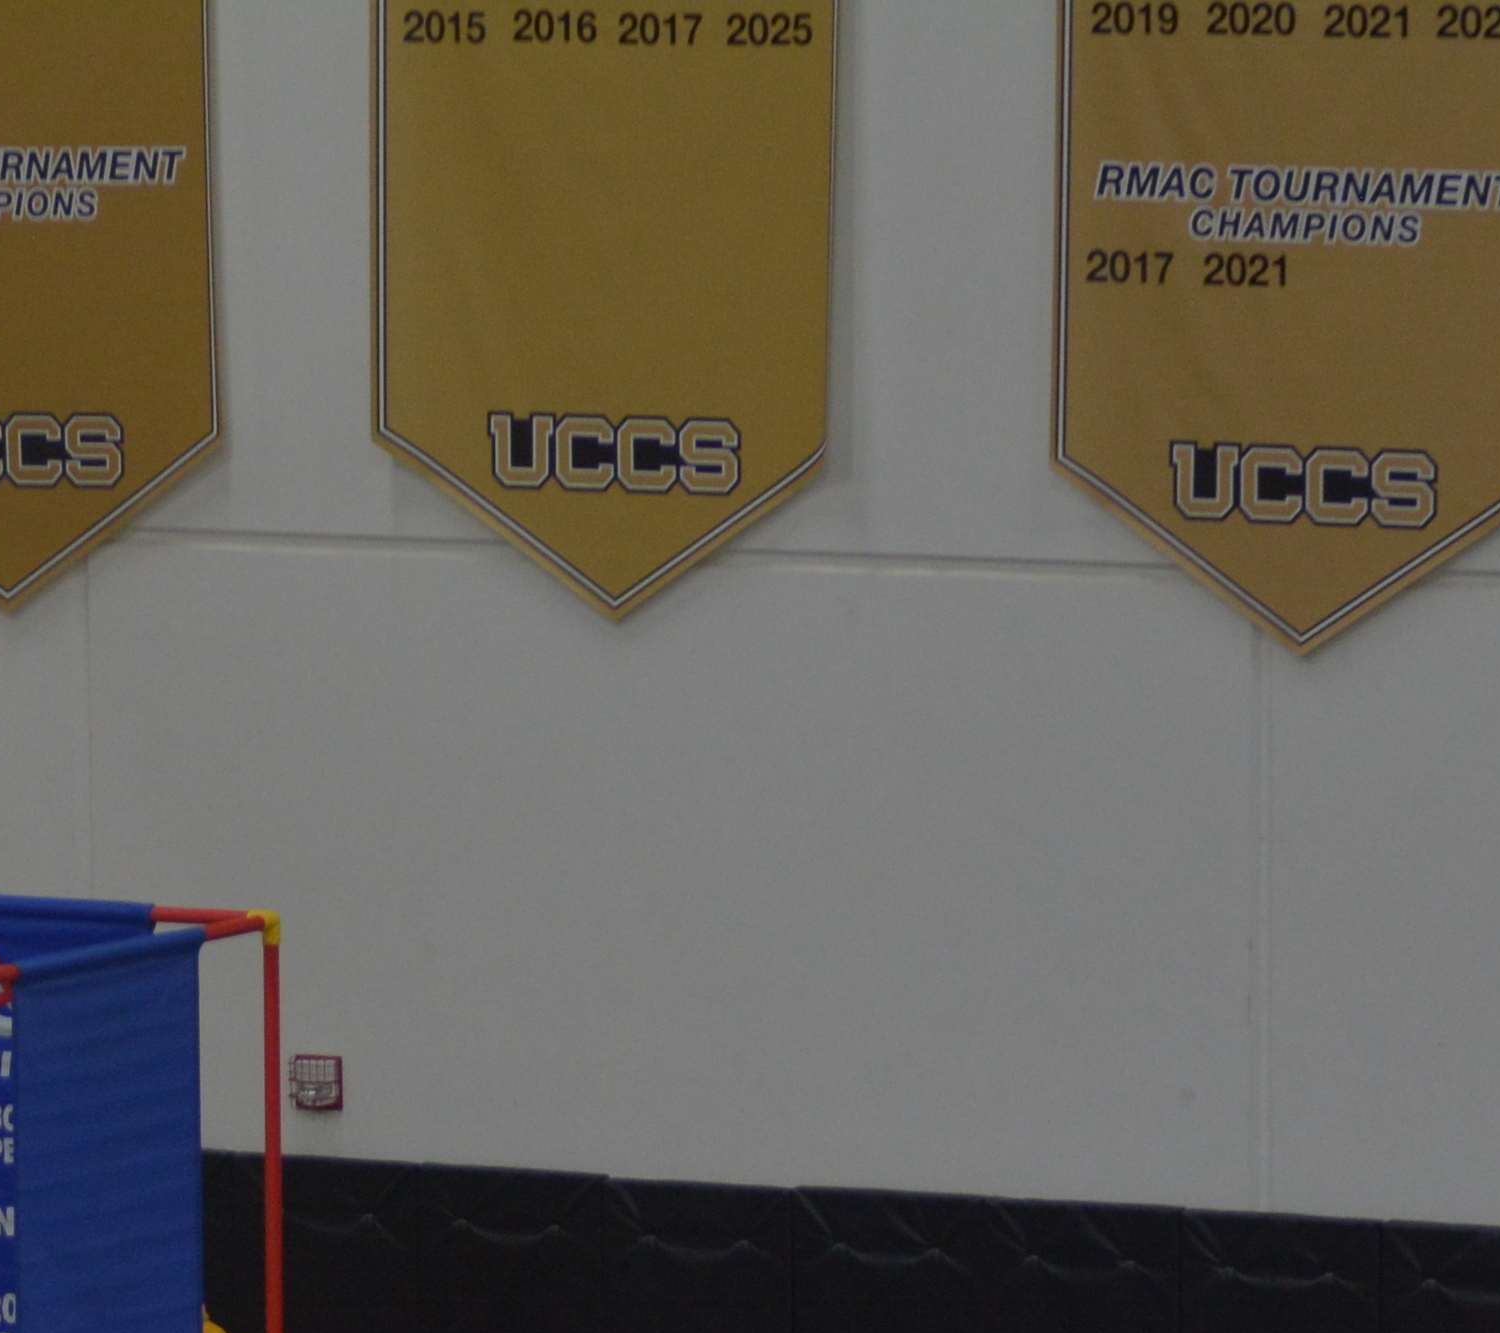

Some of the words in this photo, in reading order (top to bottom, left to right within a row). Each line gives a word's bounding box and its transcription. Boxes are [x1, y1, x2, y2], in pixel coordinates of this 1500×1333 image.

[402, 11, 487, 43] 2015
[513, 11, 598, 43] 2016
[618, 12, 702, 45] 2017
[726, 13, 813, 46] 2025
[1091, 2, 1180, 35] 2019
[1206, 3, 1297, 36] 2020
[1323, 4, 1410, 39] 2021
[1096, 164, 1216, 199] RMAC
[1189, 209, 1421, 243] CHAMPIONS
[1086, 249, 1174, 285] 2017
[1203, 252, 1288, 287] 2021
[488, 411, 742, 496] UCCS
[1169, 441, 1438, 529] UCCS
